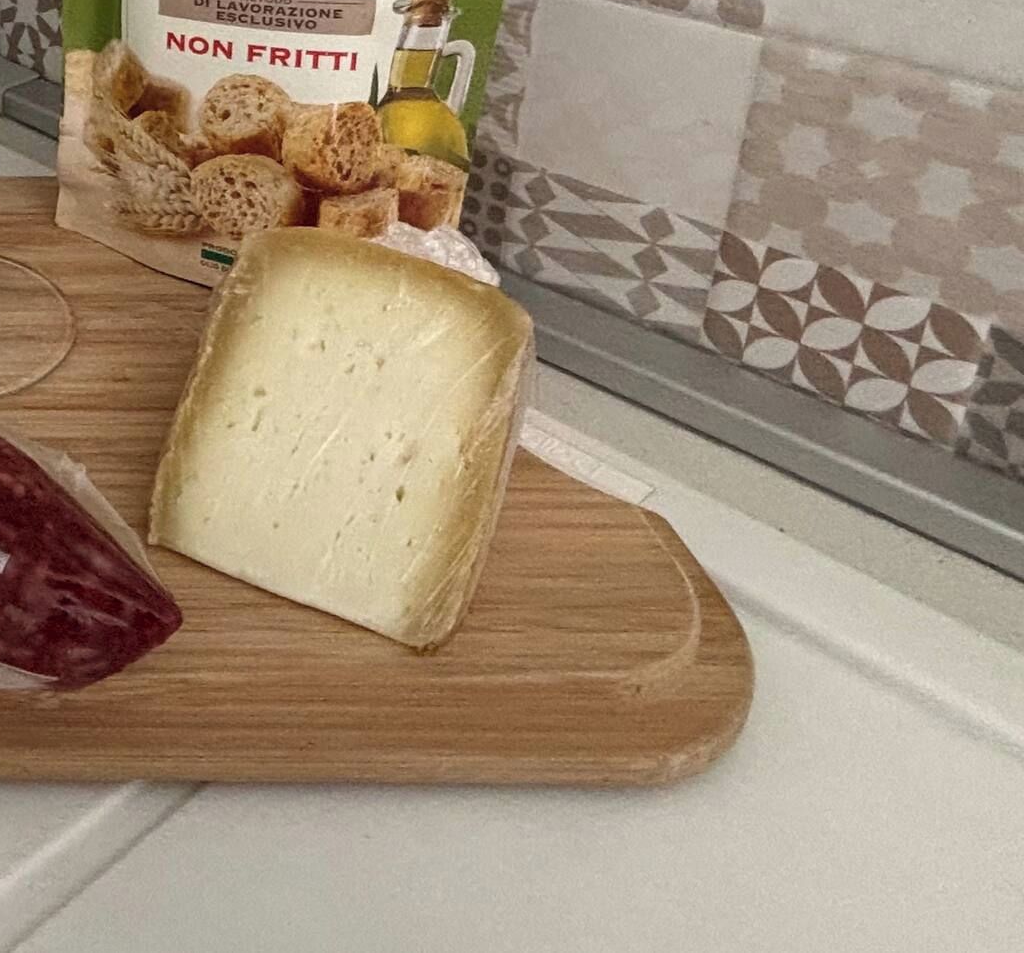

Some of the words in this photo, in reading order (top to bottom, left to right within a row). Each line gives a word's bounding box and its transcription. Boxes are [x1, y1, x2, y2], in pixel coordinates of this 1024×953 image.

[216, 0, 343, 19] LAVORAZIONE
[216, 11, 317, 30] ESCLUSIVO
[166, 32, 233, 60] NON
[247, 44, 358, 71] FRITTI
